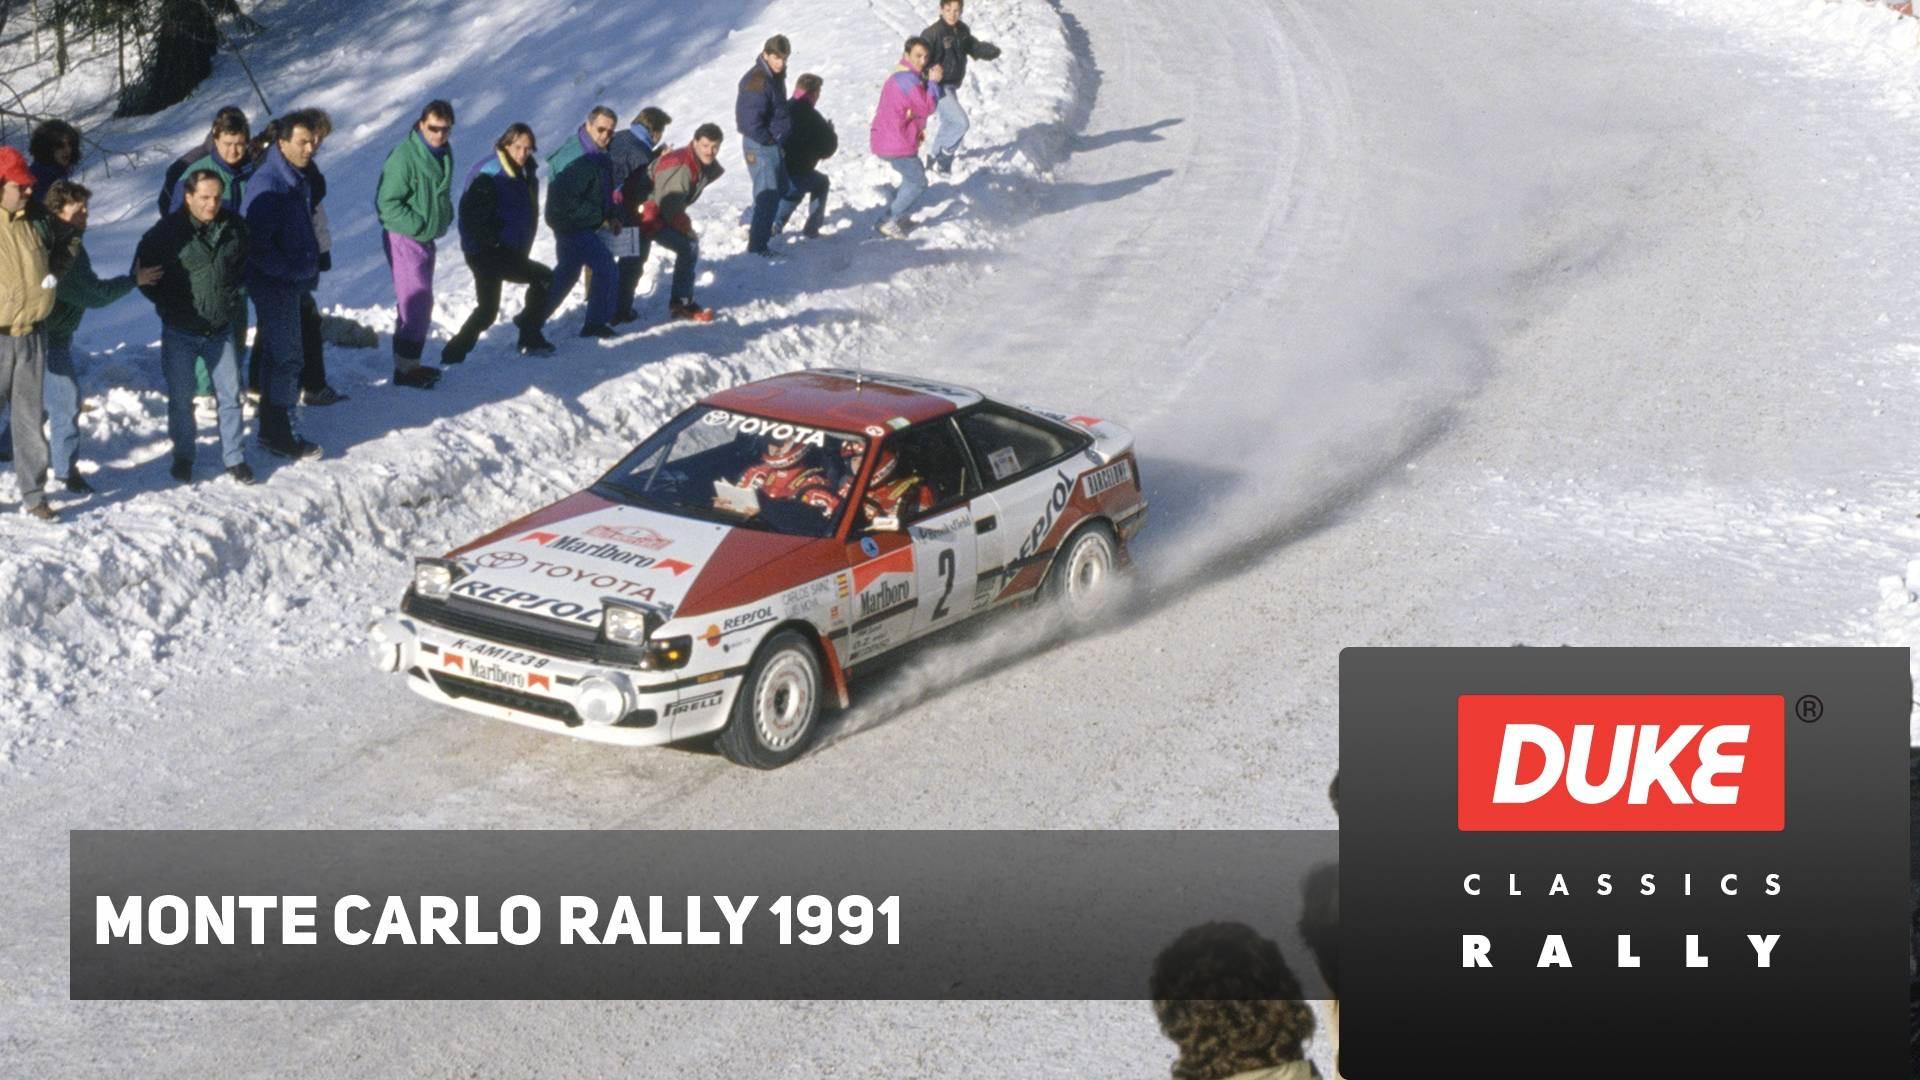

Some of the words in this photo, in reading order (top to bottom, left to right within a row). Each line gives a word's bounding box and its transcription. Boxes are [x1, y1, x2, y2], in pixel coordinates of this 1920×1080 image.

[726, 412, 826, 448] TOYOTA
[546, 535, 657, 569] Marlboro
[530, 561, 656, 602] TOYOTA
[861, 579, 910, 615] Marlboro
[931, 548, 955, 621] 2
[453, 580, 603, 623] REPSOL
[723, 606, 774, 631] REPSOL
[469, 658, 525, 688] Marlboro
[663, 690, 724, 717] PIRELLI
